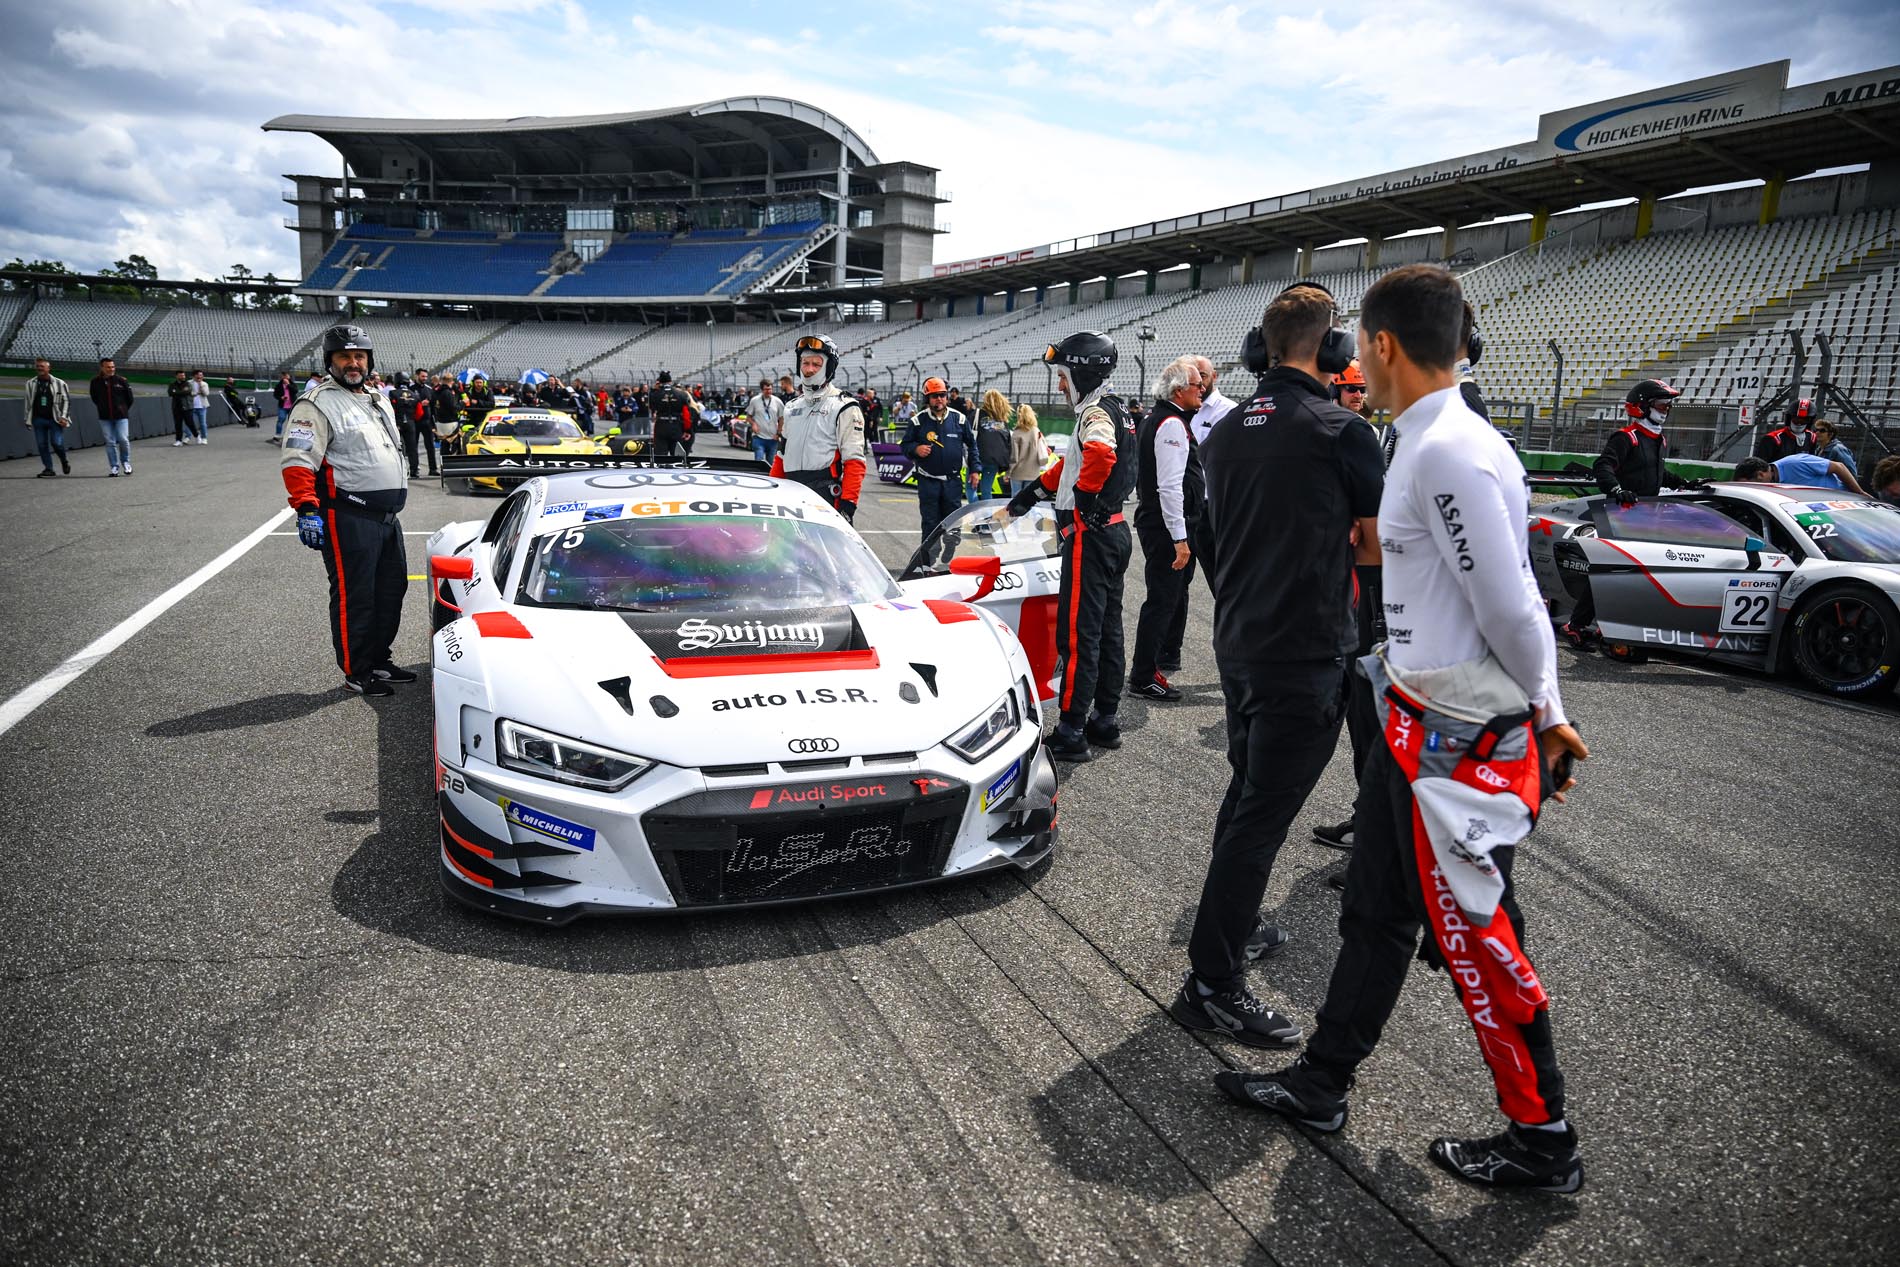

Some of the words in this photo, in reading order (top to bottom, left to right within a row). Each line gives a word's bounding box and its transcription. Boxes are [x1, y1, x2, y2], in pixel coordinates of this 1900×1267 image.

[1736, 376, 1760, 389] 17.2
[498, 457, 711, 469] AUTO-ISRCZ
[544, 503, 588, 515] PROAM
[630, 501, 804, 519] GTOPEN
[541, 526, 586, 555] 75
[1434, 493, 1475, 573] ASANO
[1808, 523, 1839, 539] 22
[1035, 569, 1062, 583] au
[1731, 596, 1770, 626] 22
[677, 618, 824, 650] Svijany
[1643, 628, 1767, 651] FULLVANS
[711, 693, 788, 712] auto
[795, 688, 878, 704] I.S.R.
[441, 774, 465, 794] R8
[777, 786, 825, 803] Audi
[830, 783, 887, 801] Sport
[994, 768, 1018, 796] MICHELIN
[522, 814, 583, 841] MICHELIN
[1430, 863, 1472, 953] Sport
[1453, 958, 1500, 1029] Audi
